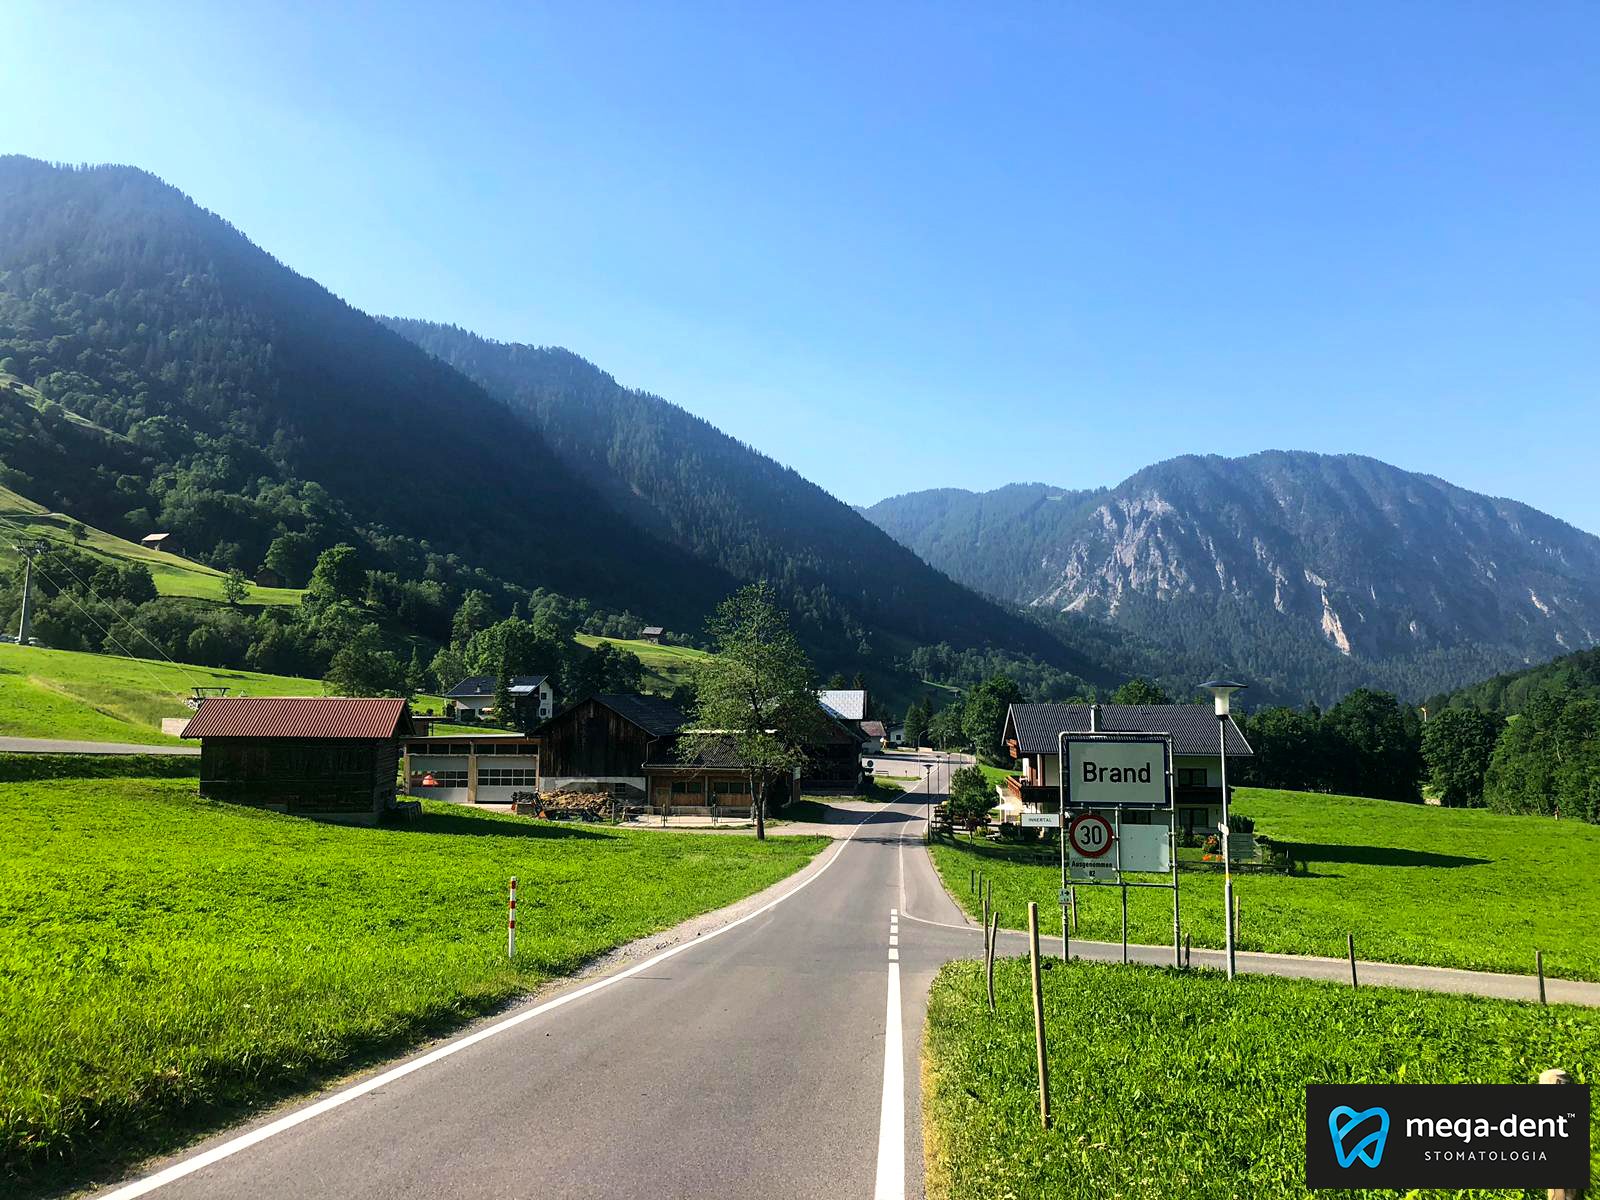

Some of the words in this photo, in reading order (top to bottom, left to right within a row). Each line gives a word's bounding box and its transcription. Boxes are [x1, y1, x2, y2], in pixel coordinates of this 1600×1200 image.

[1083, 762, 1151, 783] Brand
[1080, 825, 1102, 845] 30
[1071, 860, 1112, 868] Ausgenommen
